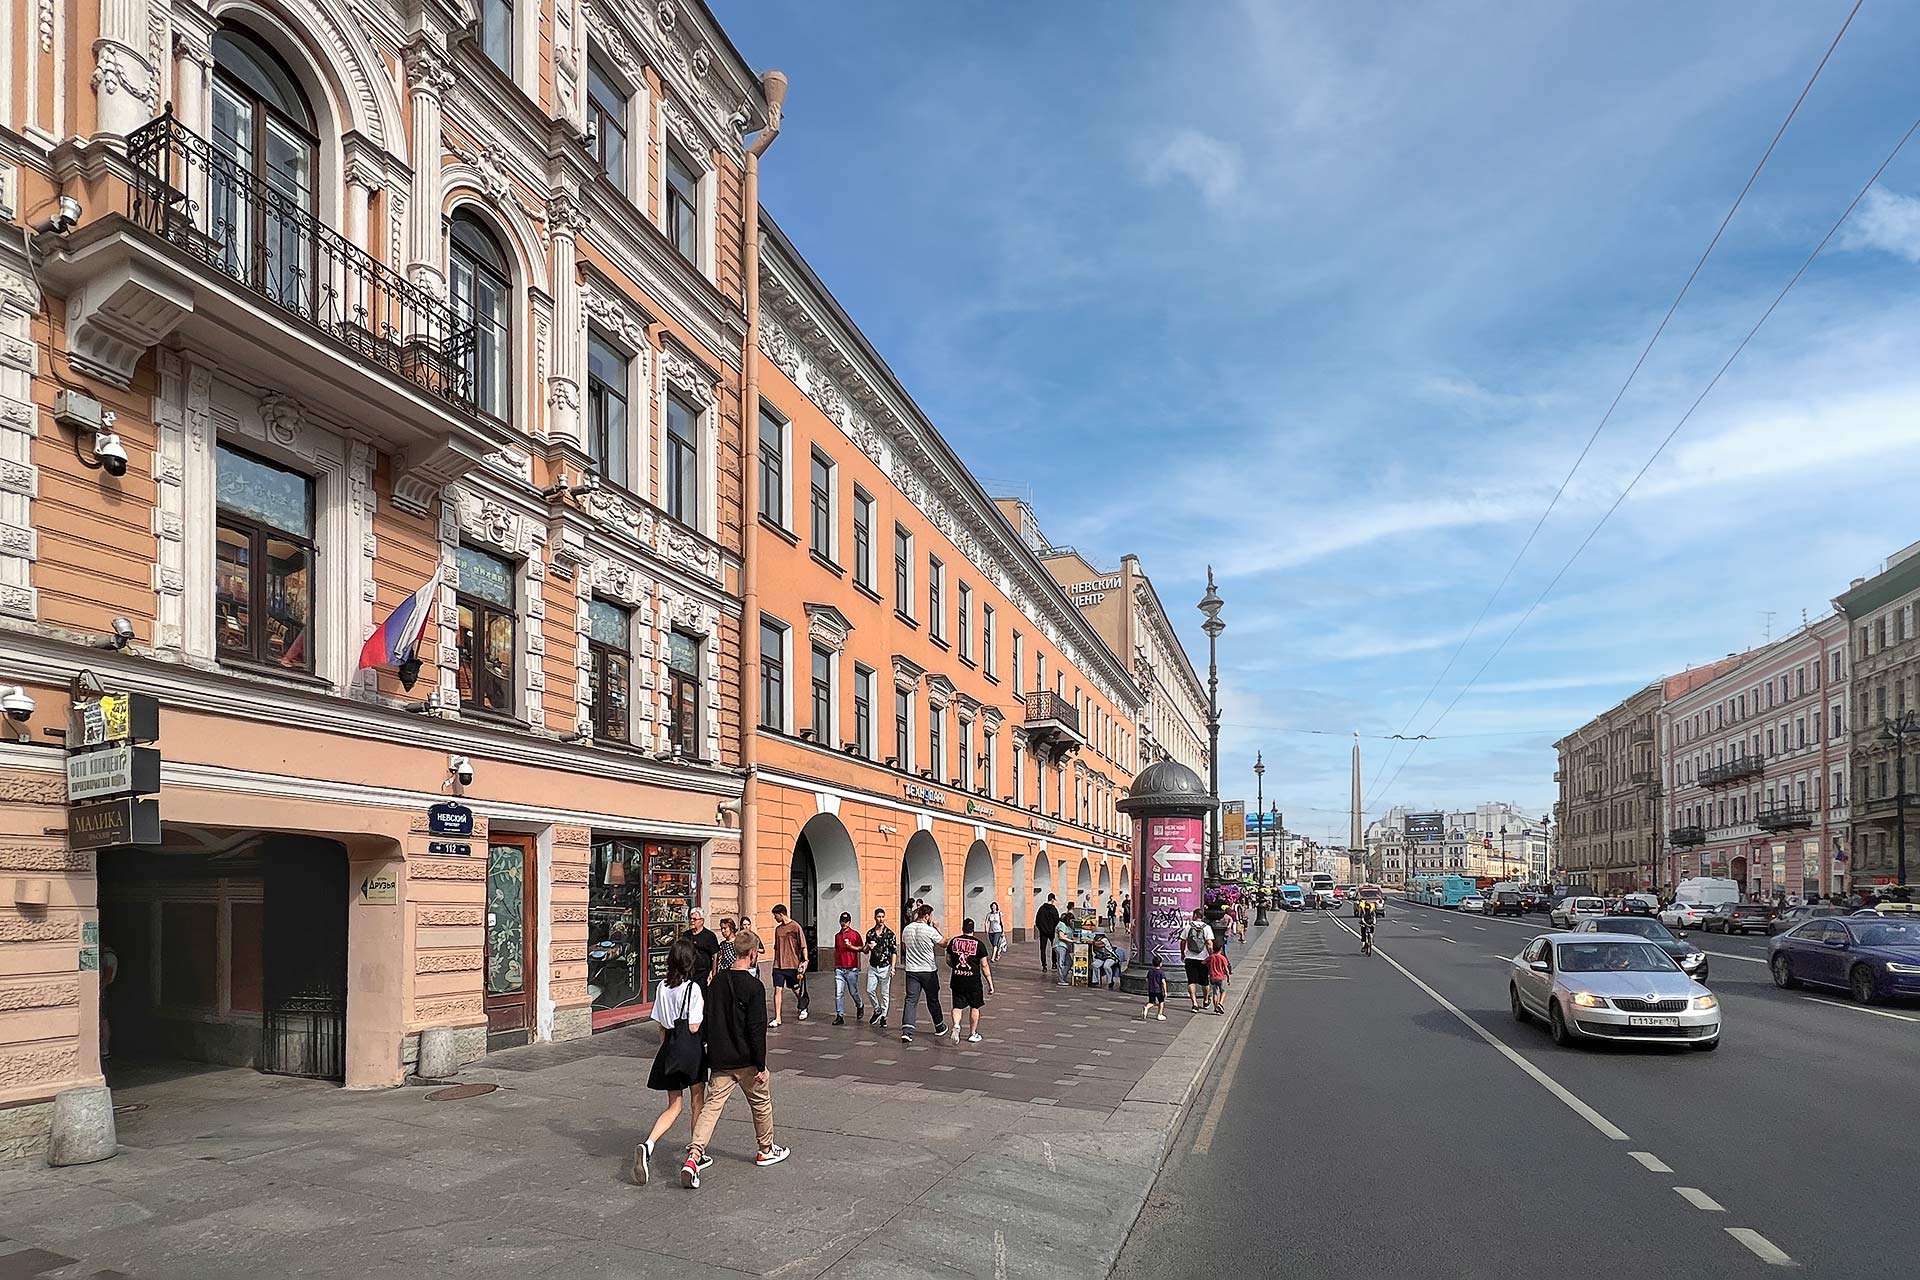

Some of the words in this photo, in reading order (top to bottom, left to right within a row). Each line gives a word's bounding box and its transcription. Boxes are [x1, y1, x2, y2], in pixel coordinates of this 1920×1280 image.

[1071, 576, 1121, 593] НЕВСКИЙ
[1072, 593, 1105, 608] ЦЕНТР
[75, 811, 123, 833] МАЛИКА
[437, 813, 467, 823] НЕВСКИЙ
[445, 844, 457, 853] 112
[1153, 873, 1160, 881] В
[1163, 873, 1193, 882] ШАГЕ
[1152, 896, 1177, 906] ЕДЫ
